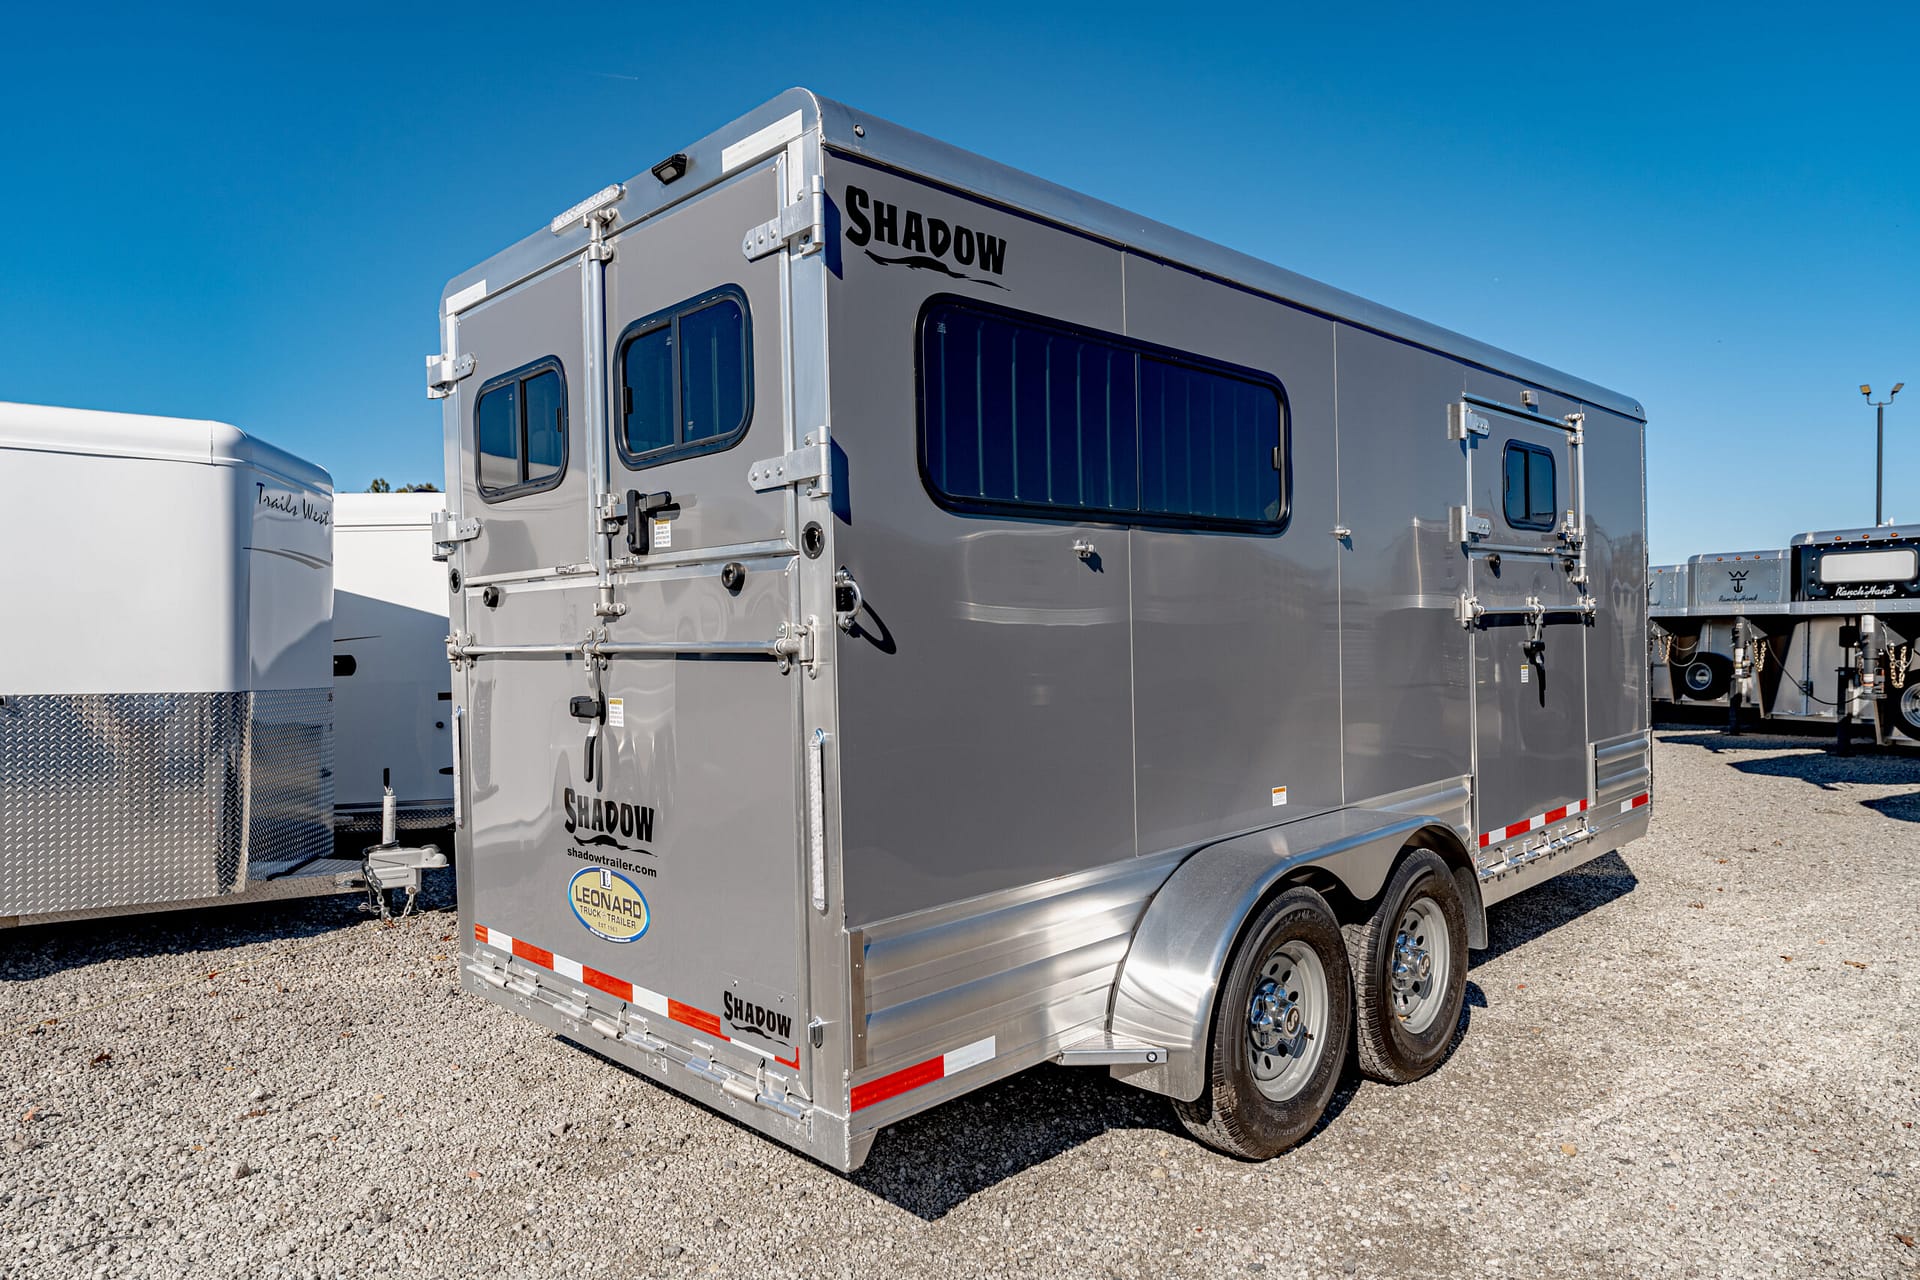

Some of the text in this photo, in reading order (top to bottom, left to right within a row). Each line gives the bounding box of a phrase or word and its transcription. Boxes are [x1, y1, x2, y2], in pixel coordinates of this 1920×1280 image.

[845, 184, 1007, 275] SHADOW
[256, 482, 330, 526] Trails West
[1835, 586, 1863, 596] Ranch
[564, 787, 654, 843] SHADOW
[567, 847, 657, 877] shadowtrailer.com
[575, 885, 642, 920] LEONARD
[580, 905, 636, 929] TRUCK TRAILER
[723, 991, 792, 1039] SHADOW
